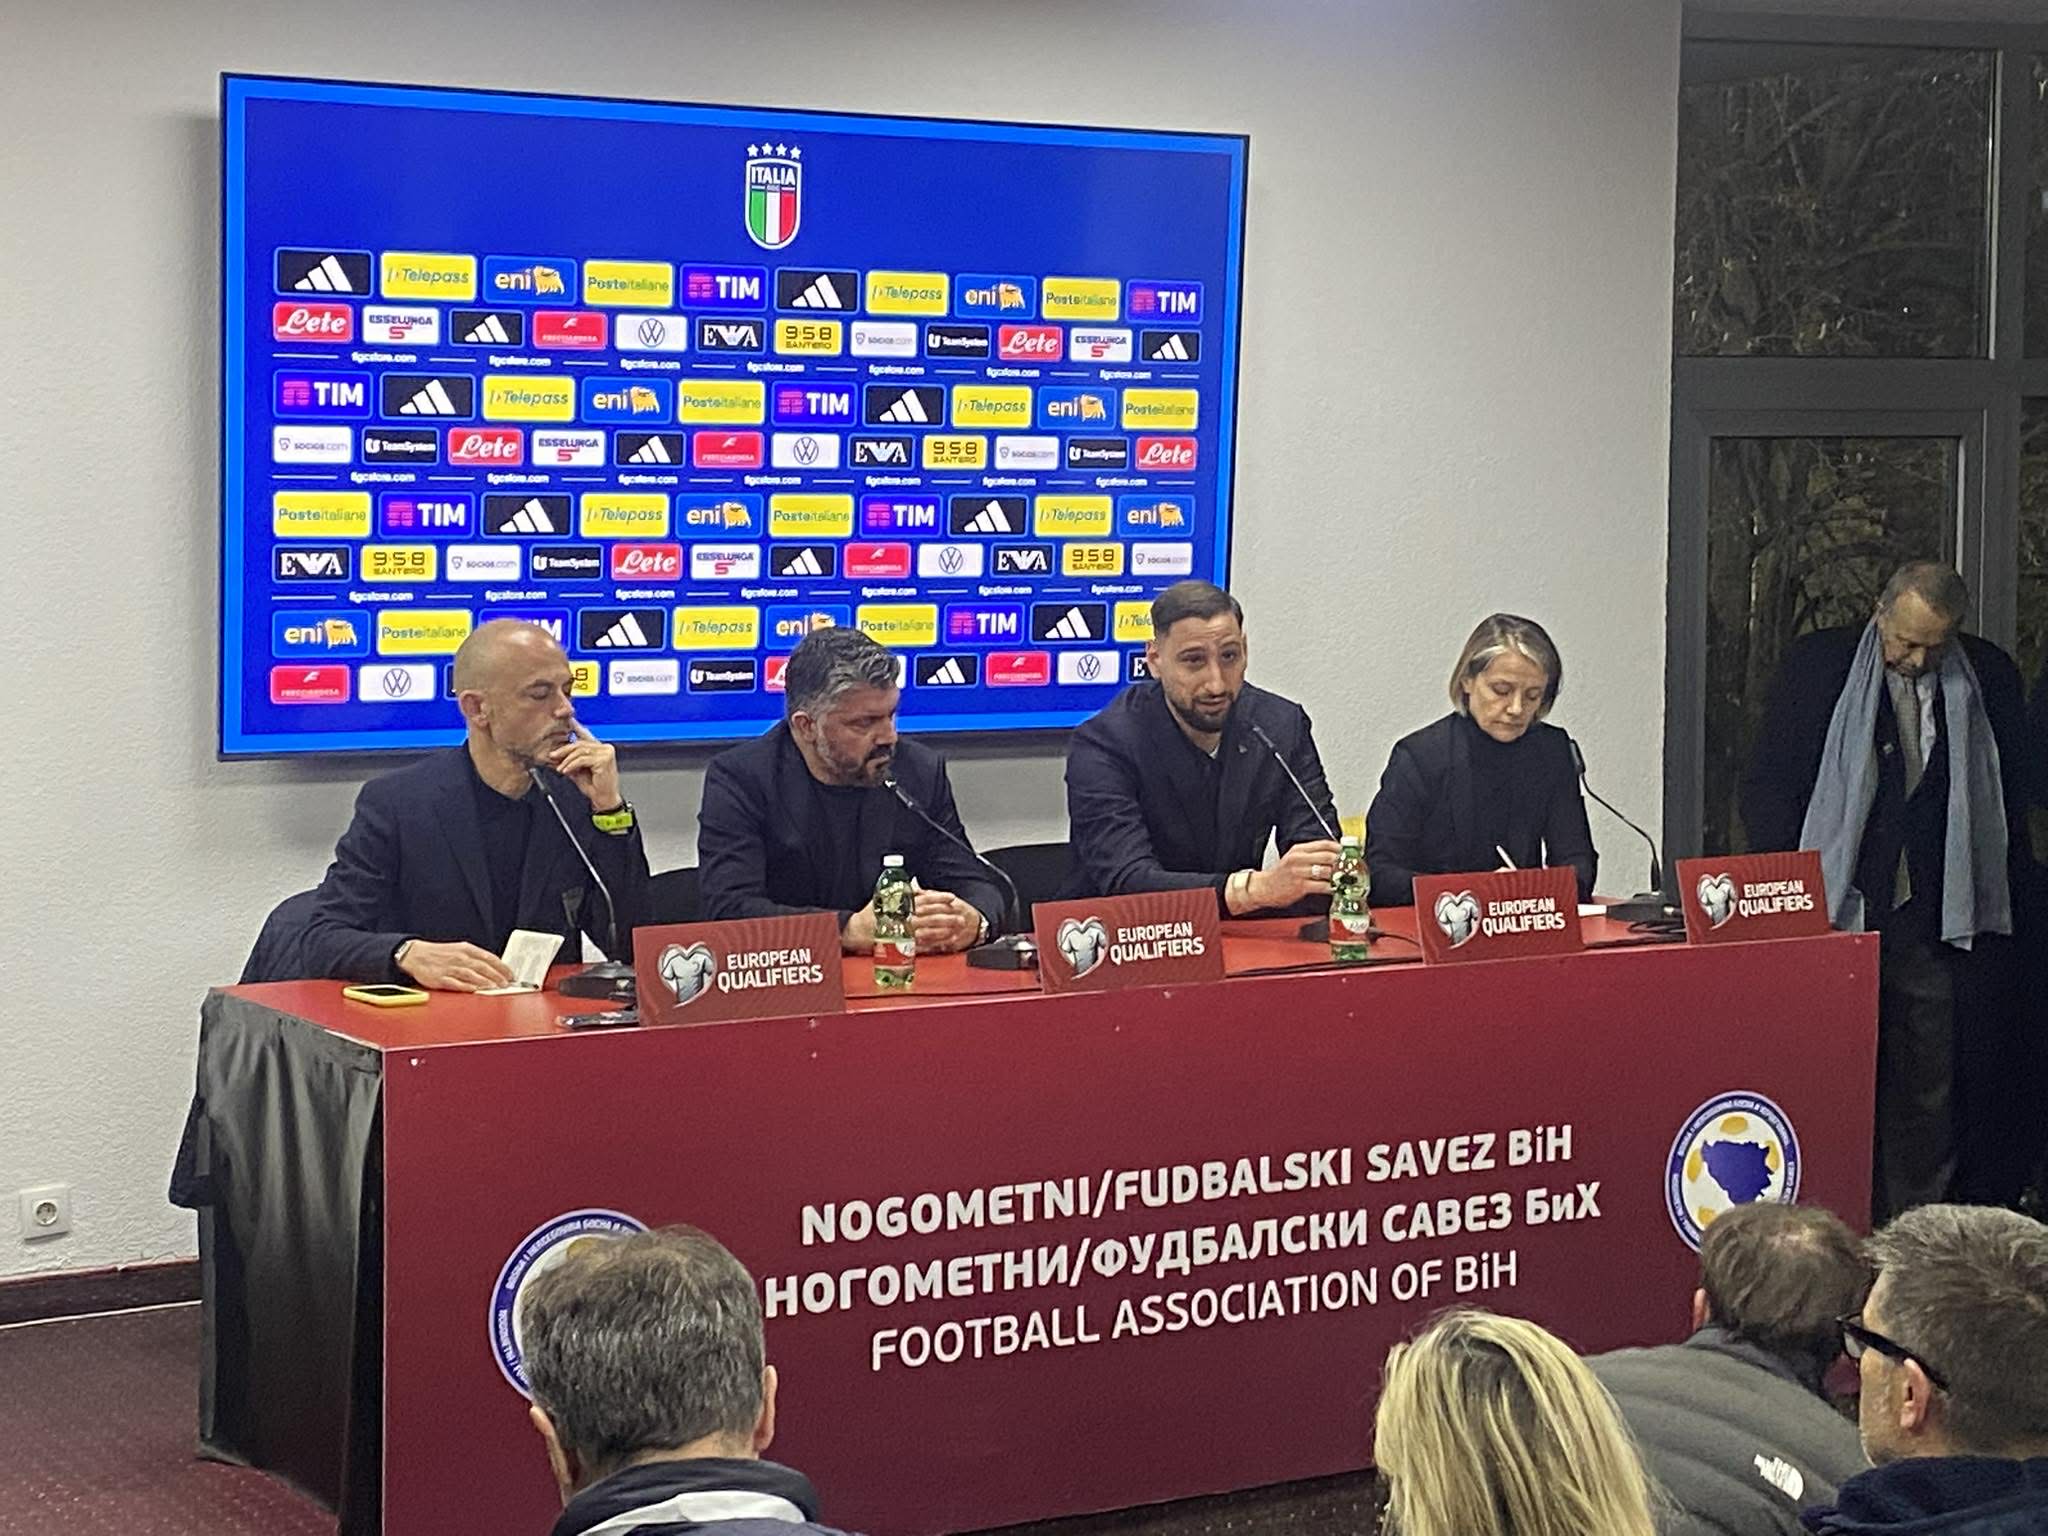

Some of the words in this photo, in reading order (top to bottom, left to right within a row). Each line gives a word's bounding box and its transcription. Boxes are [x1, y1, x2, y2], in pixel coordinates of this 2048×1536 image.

[751, 167, 796, 185] ITALIA
[495, 269, 532, 290] eni
[716, 276, 760, 300] TIM
[965, 283, 996, 305] eni
[1157, 291, 1196, 313] TIM
[278, 308, 347, 334] Lete
[1001, 331, 1058, 354] Lete
[313, 382, 364, 406] TIM
[592, 390, 629, 410] eni
[806, 392, 849, 415] TIM
[1048, 398, 1079, 417] eni
[452, 435, 517, 460] Lete
[1139, 442, 1192, 465] Lete
[417, 503, 465, 527] TIM
[687, 505, 720, 525] eni
[893, 505, 935, 527] TIM
[1127, 505, 1157, 525] eni
[615, 550, 676, 574] Lete
[284, 621, 323, 644] eni
[776, 614, 809, 635] eni
[977, 612, 1017, 635] TIM
[1744, 880, 1804, 898] EUROPEAN
[1489, 898, 1555, 916] EUROPEAN
[1739, 894, 1814, 918] QUALIFIERS
[1118, 922, 1193, 943] EUROPEAN
[1482, 912, 1566, 938] QUALIFIERS
[727, 949, 811, 970] EUROPEAN
[1110, 937, 1205, 965] QUALIFIERS
[718, 964, 824, 994] QUALIFIERS
[801, 1147, 1352, 1246] NOGOMETNI/FUDBALSKI
[1366, 1132, 1496, 1182] SAVEZ
[1508, 1124, 1572, 1168] BiH
[764, 1209, 1368, 1319] НОГОМЕТНИ/ФУДБАЛСКИ
[1382, 1192, 1513, 1243] САВЕЗ
[1526, 1182, 1601, 1225] БиХ
[871, 1305, 1100, 1371] FOOTBALL
[1111, 1267, 1378, 1340] ASSOCIATION
[1391, 1258, 1443, 1302] OF
[1455, 1250, 1518, 1293] BiH
